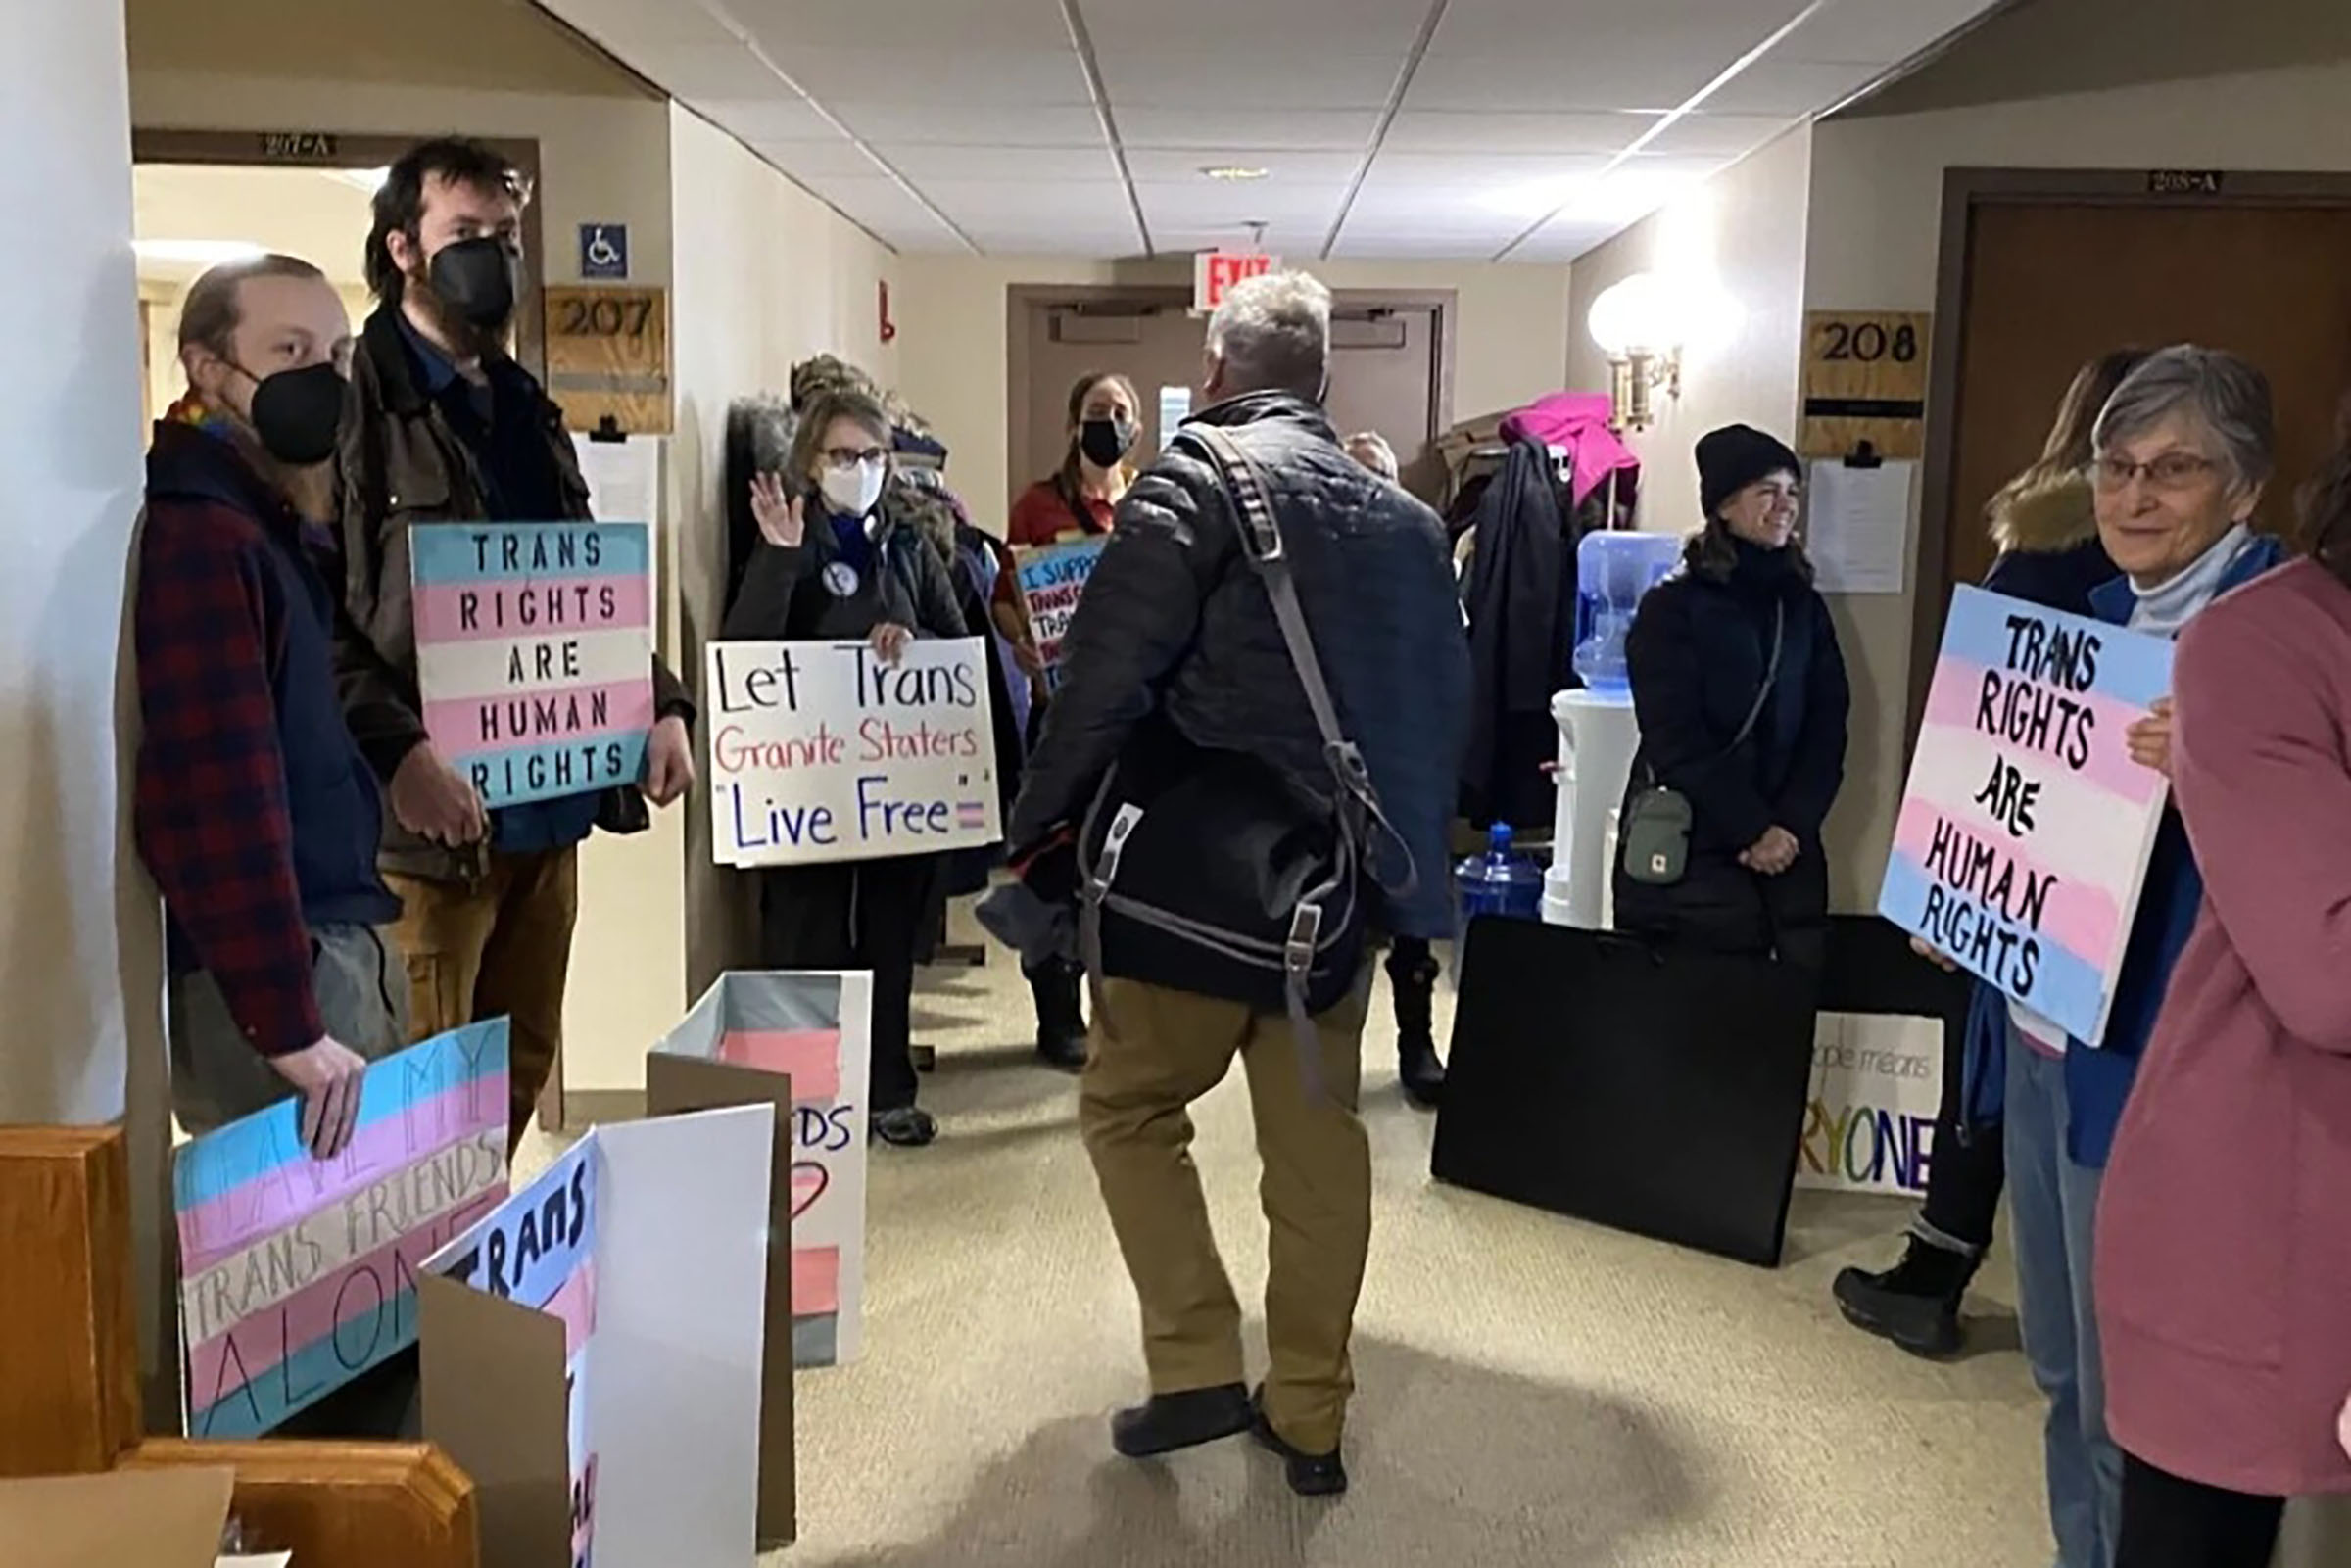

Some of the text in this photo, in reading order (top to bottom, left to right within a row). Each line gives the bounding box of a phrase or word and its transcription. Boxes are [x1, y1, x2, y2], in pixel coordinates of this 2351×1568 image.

[560, 296, 653, 338] 207
[1822, 321, 1917, 363] 208
[471, 531, 602, 573] TRANS
[459, 585, 616, 632] RIGHTS
[508, 641, 581, 684] ARE
[715, 642, 978, 713] Let Trans
[2003, 613, 2102, 694] TRANS
[479, 689, 608, 742] HUMAN
[1975, 669, 2095, 771] RIGHTS
[470, 742, 624, 801] RIGHTS
[715, 716, 978, 774] Granite Staters
[1975, 752, 2041, 837] ARE
[1924, 816, 2058, 933] HUMAN
[1919, 883, 2040, 998] RIGHTS
[402, 1022, 499, 1156] MY
[1860, 1047, 1930, 1078] means
[791, 1105, 853, 1152] DS
[194, 1135, 503, 1338] TRANS FRIENDS
